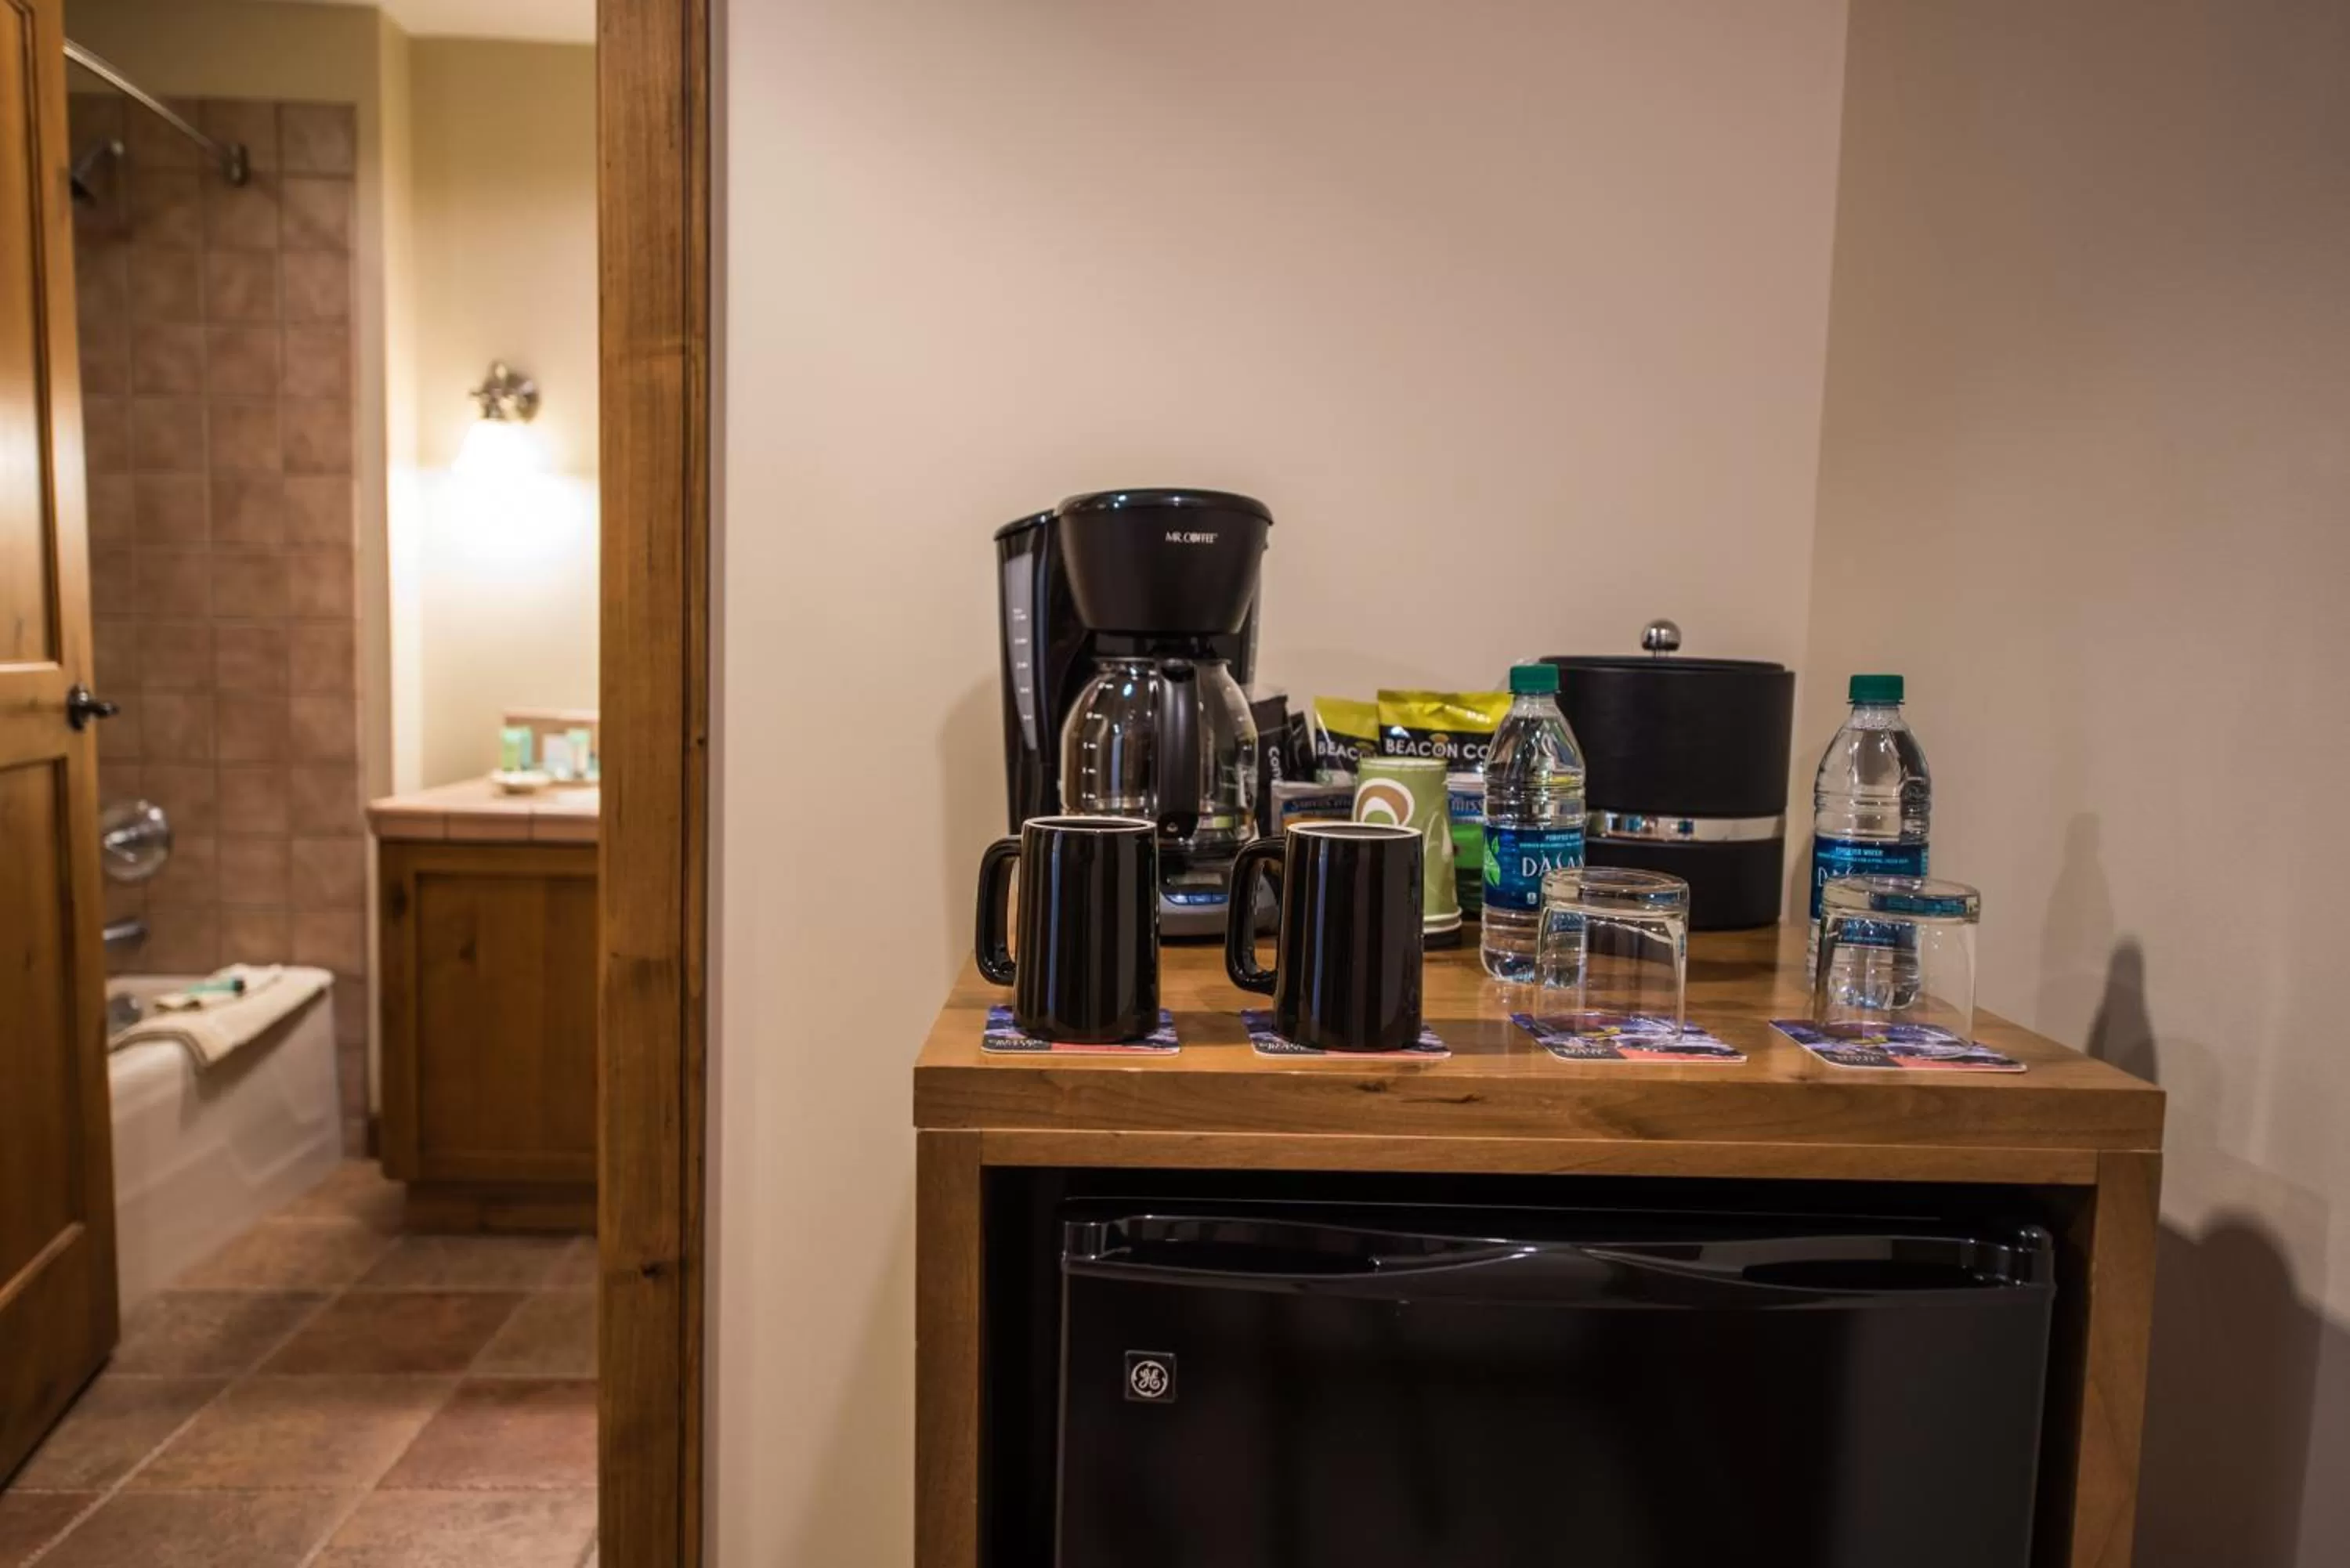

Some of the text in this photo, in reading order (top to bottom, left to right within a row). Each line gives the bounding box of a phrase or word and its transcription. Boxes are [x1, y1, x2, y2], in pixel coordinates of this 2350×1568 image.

[1165, 531, 1215, 544] MR. COFFEE
[1385, 739, 1458, 758] BEACON
